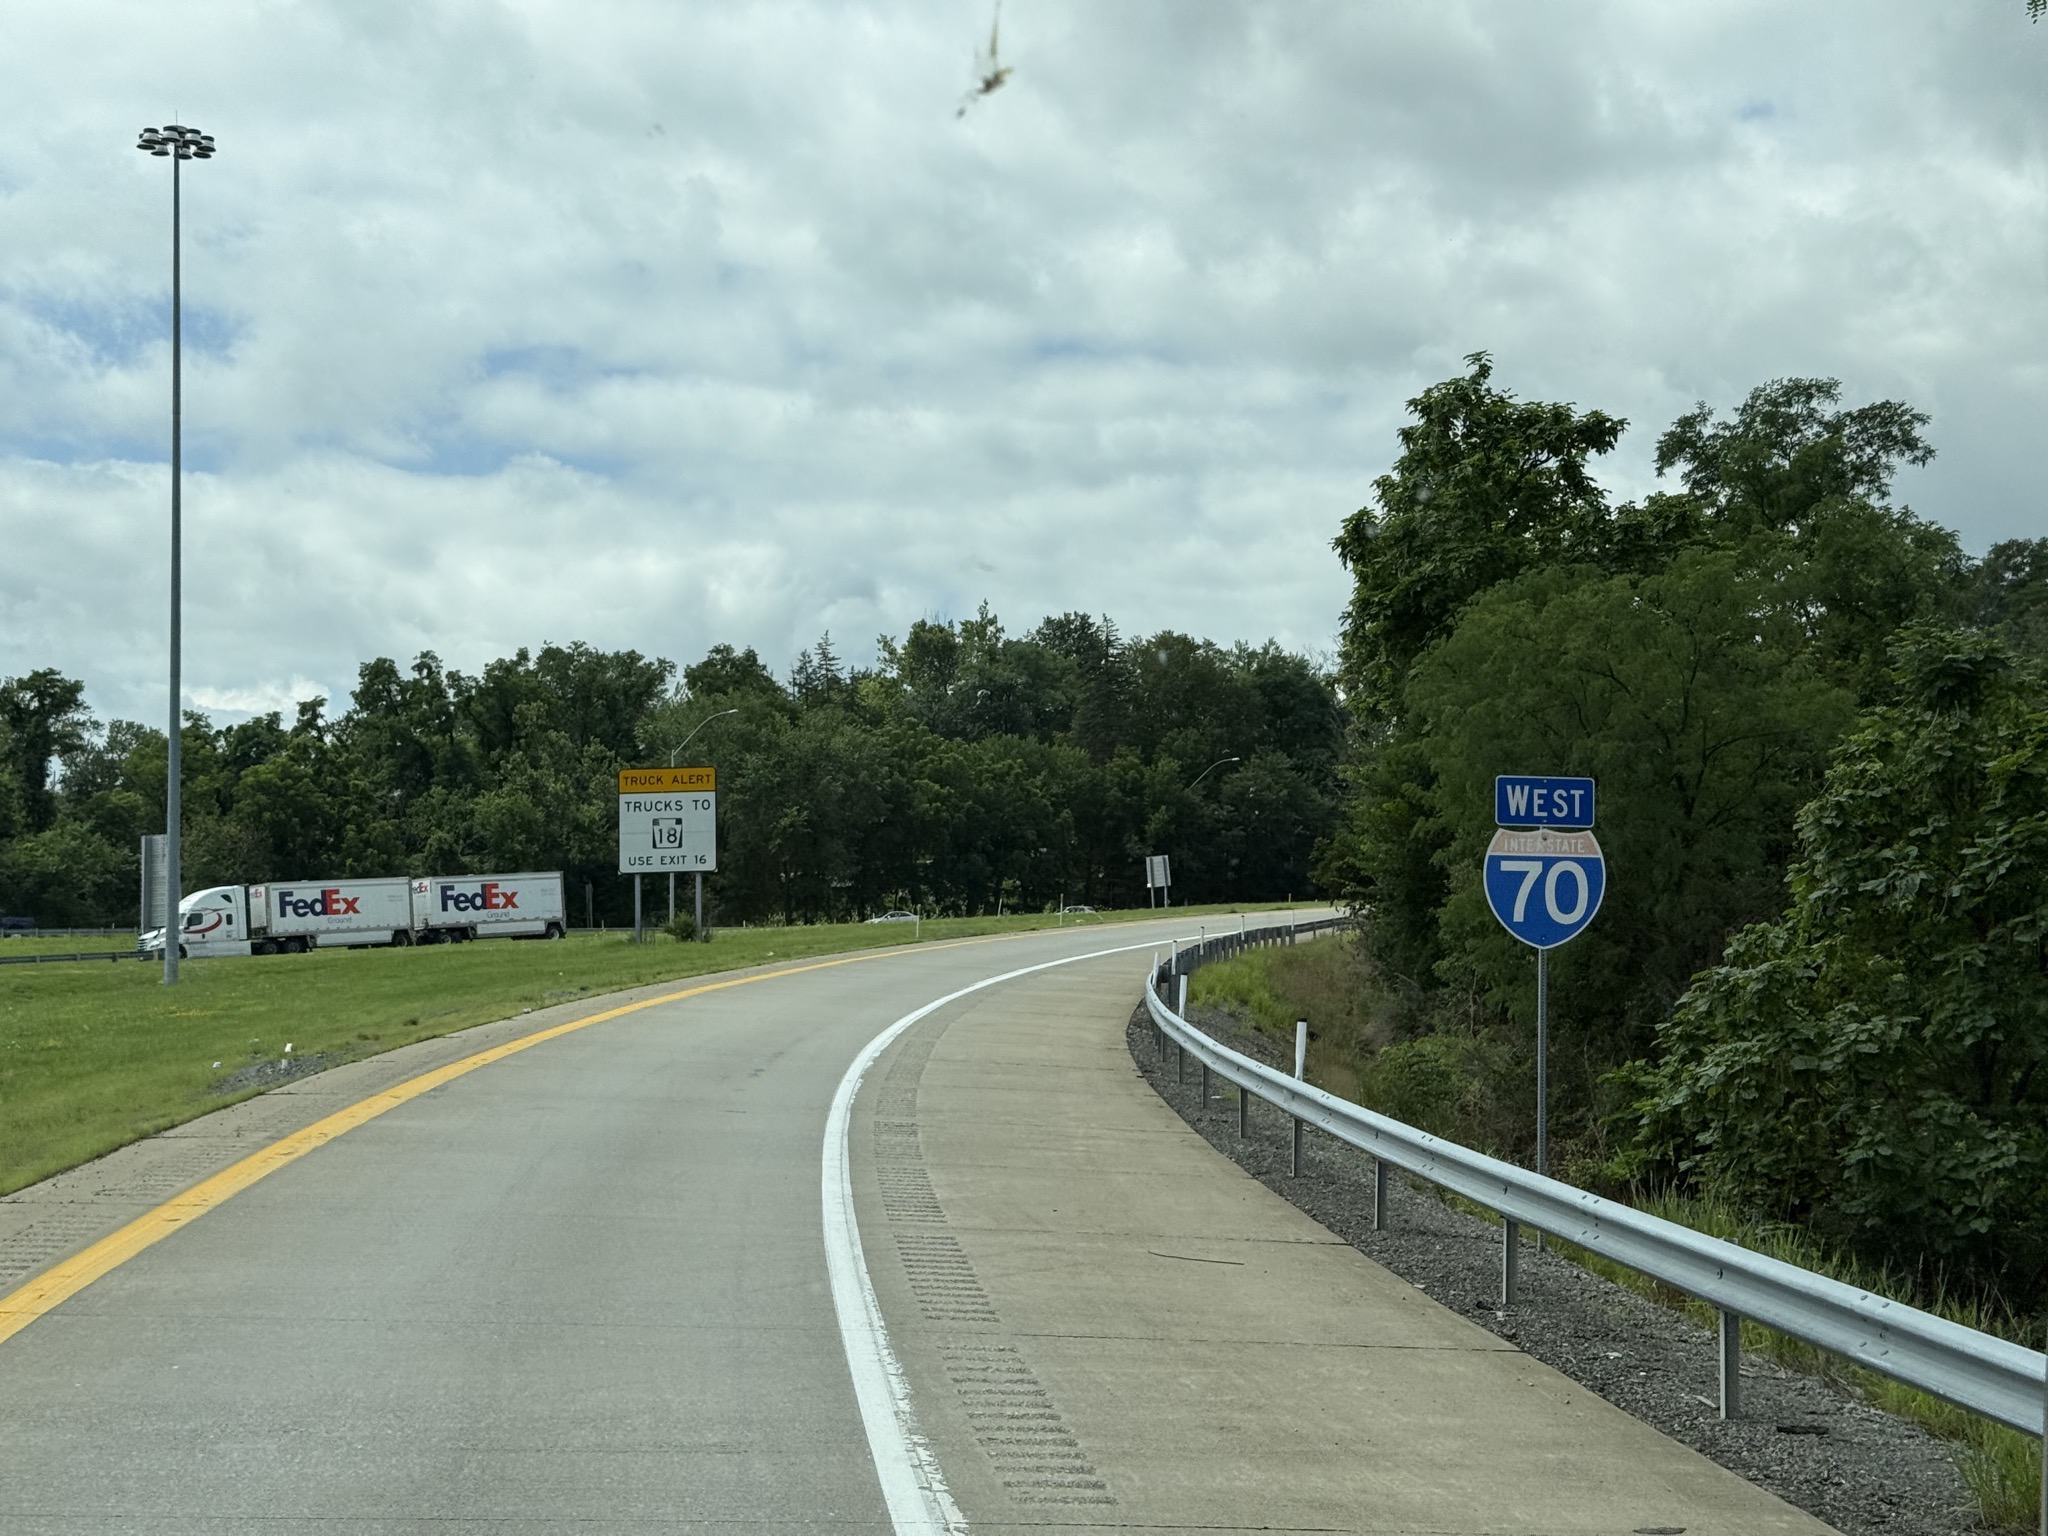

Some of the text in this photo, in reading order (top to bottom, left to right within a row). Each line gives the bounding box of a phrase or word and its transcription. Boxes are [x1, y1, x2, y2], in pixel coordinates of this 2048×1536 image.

[623, 774, 712, 786] TRUCK ALERT
[624, 799, 711, 813] TRUCKS TO
[1506, 785, 1585, 818] WEST
[658, 827, 678, 844] 18
[628, 854, 707, 866] USE EXIT 16
[440, 882, 519, 912] FedEx
[1500, 860, 1589, 925] 70
[278, 888, 362, 918] FedEx
[327, 916, 353, 924] Ground
[487, 910, 510, 918] Ground
